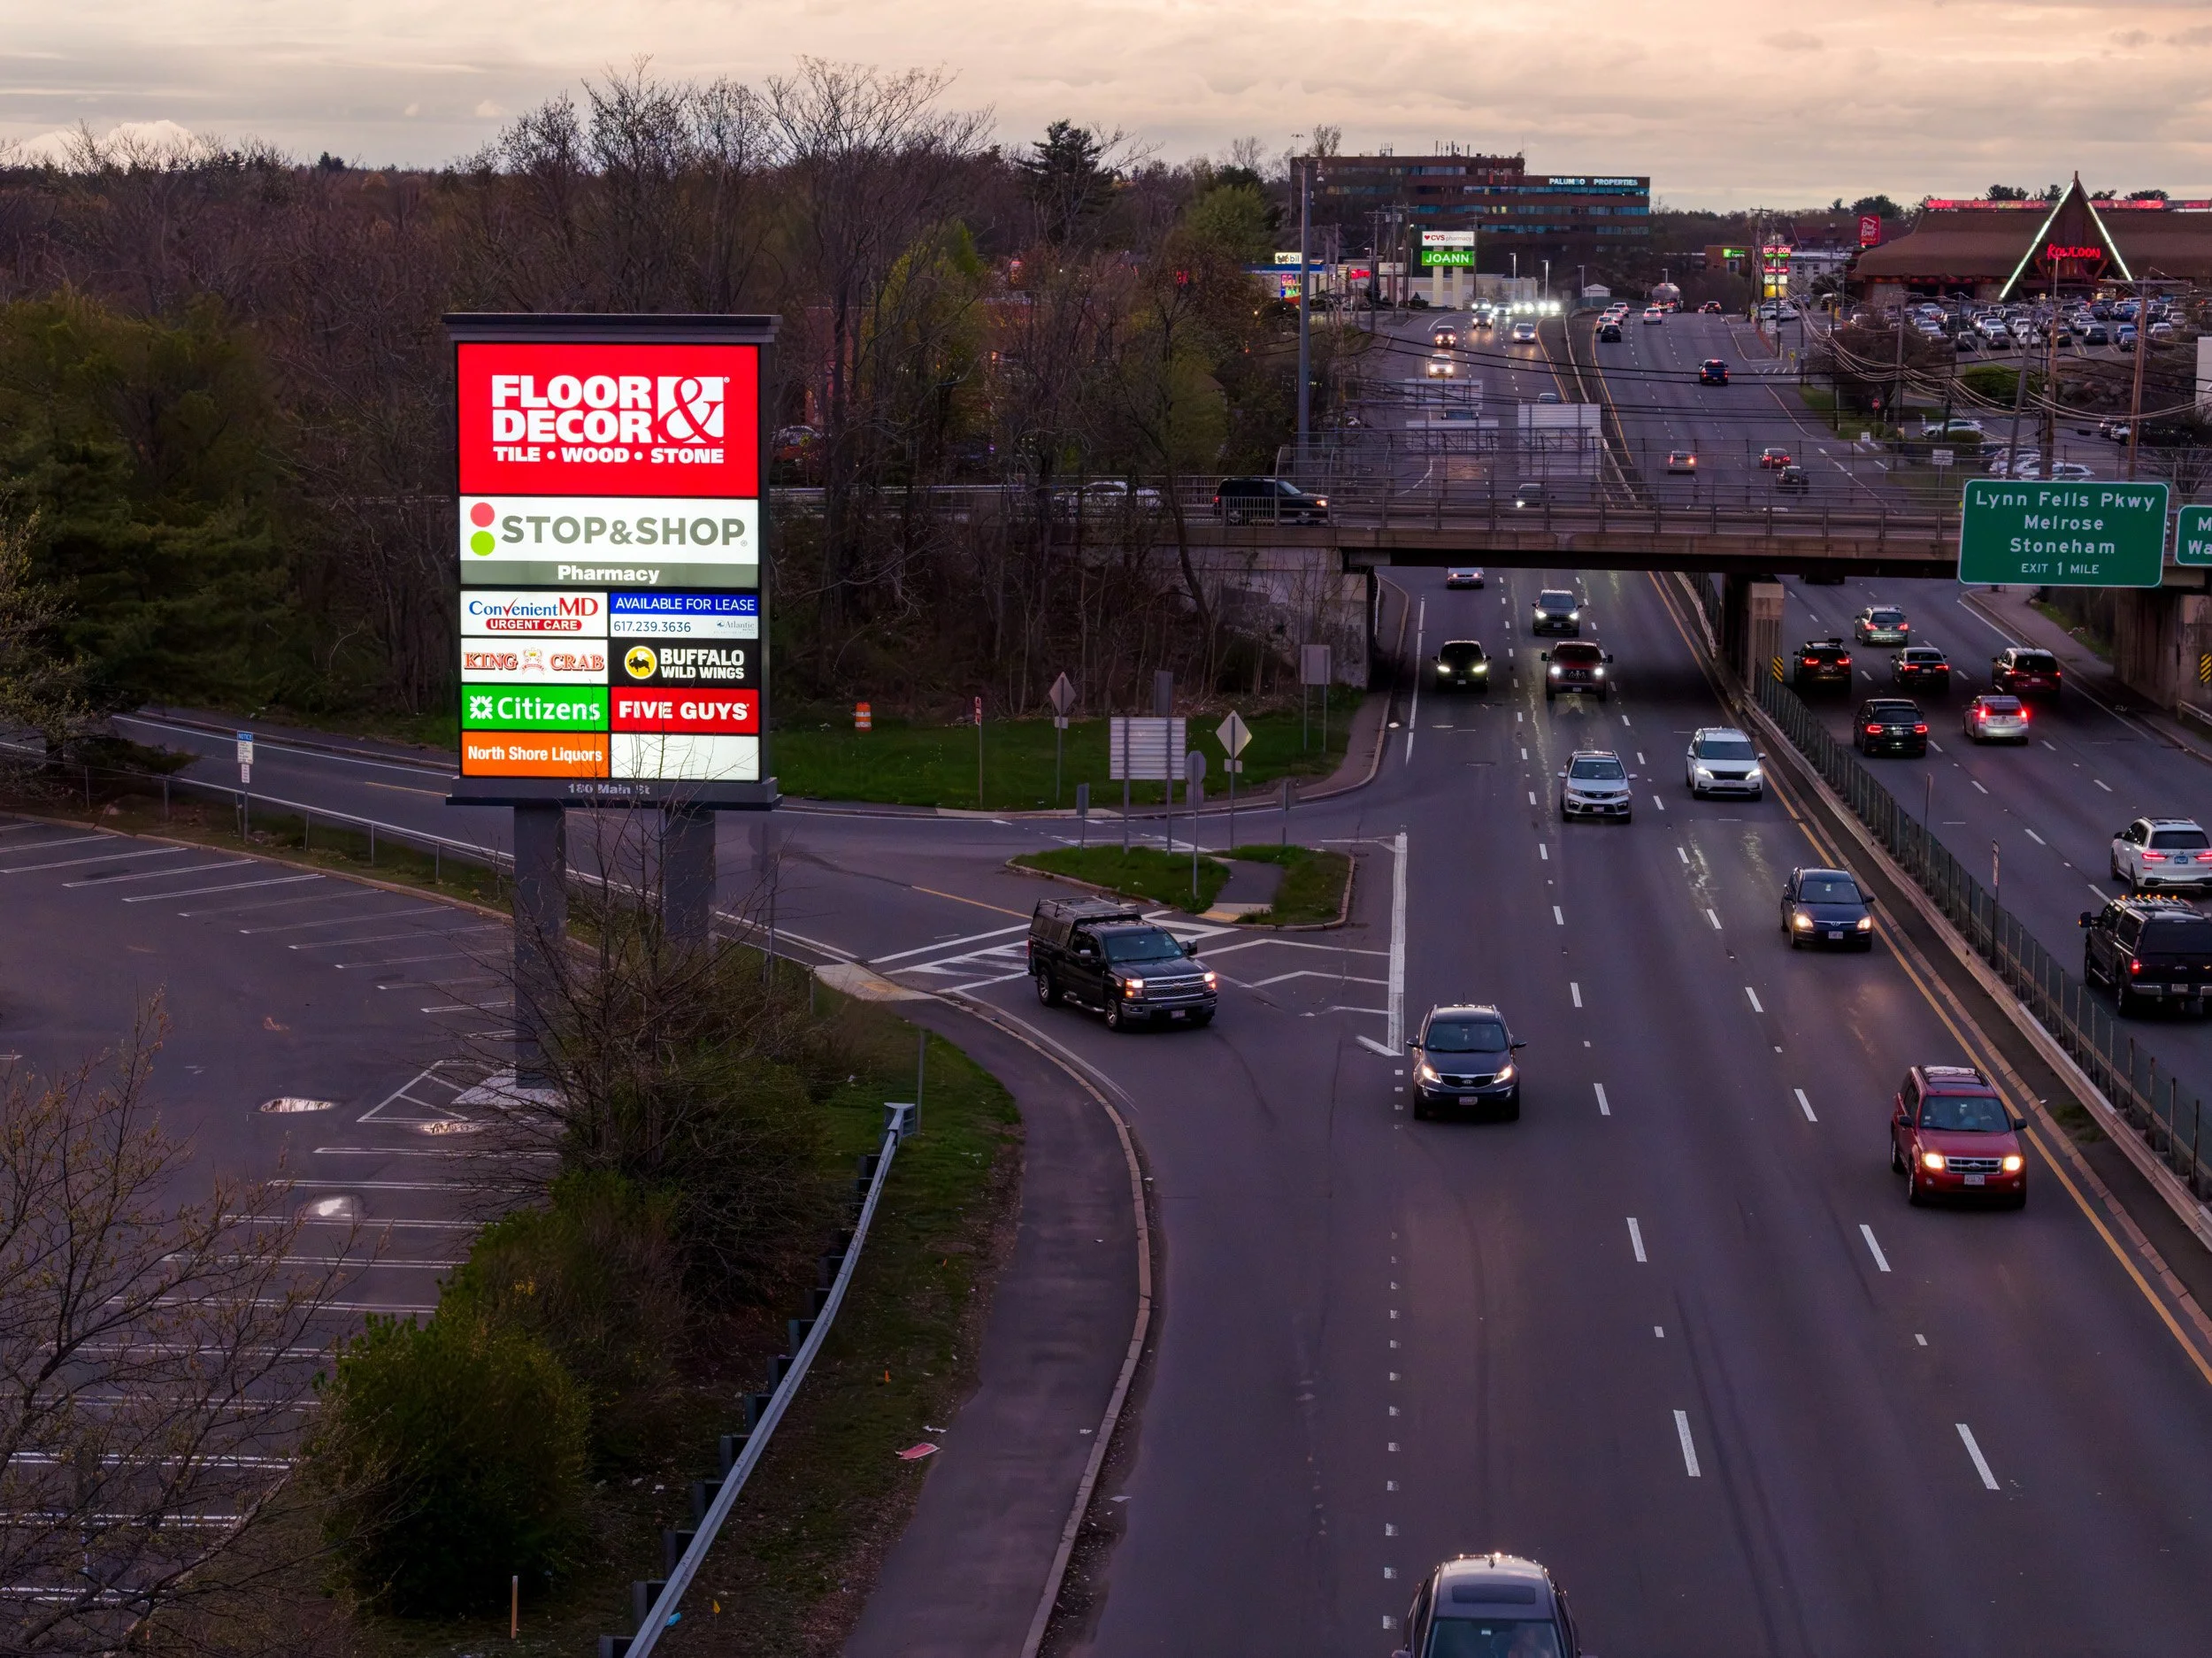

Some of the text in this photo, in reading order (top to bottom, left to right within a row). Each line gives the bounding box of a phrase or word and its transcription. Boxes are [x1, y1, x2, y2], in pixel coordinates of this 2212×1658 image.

[1425, 254, 1469, 263] JOANN
[2047, 243, 2101, 260] KOWLOON
[492, 374, 652, 409] FLOOR
[493, 409, 652, 443] DECOR
[493, 447, 724, 464] TILE WOOD STONE
[1976, 490, 2155, 511] Lynn Fells Pkwy
[501, 515, 746, 546] STOP&SHOP
[2024, 515, 2104, 530] Melrose
[2009, 537, 2116, 554] Stoneham
[557, 564, 660, 584] Pharmacy
[2021, 562, 2100, 576] EXIT 1 MILE
[469, 597, 598, 618] ConvenientMD
[615, 597, 755, 611] AVAILABLE FOR LEASE
[490, 619, 578, 630] URGENT CARE
[613, 620, 691, 633] 617.239.3636
[464, 651, 604, 672] KING CRAB
[660, 649, 744, 666] BUFFALO
[661, 666, 744, 679] WILD WINGS
[497, 696, 601, 720] Citizens
[619, 701, 748, 720] FIVE GUYS
[468, 746, 603, 764] North Shore Liquors
[597, 784, 631, 794] Main
[636, 785, 650, 794] St
